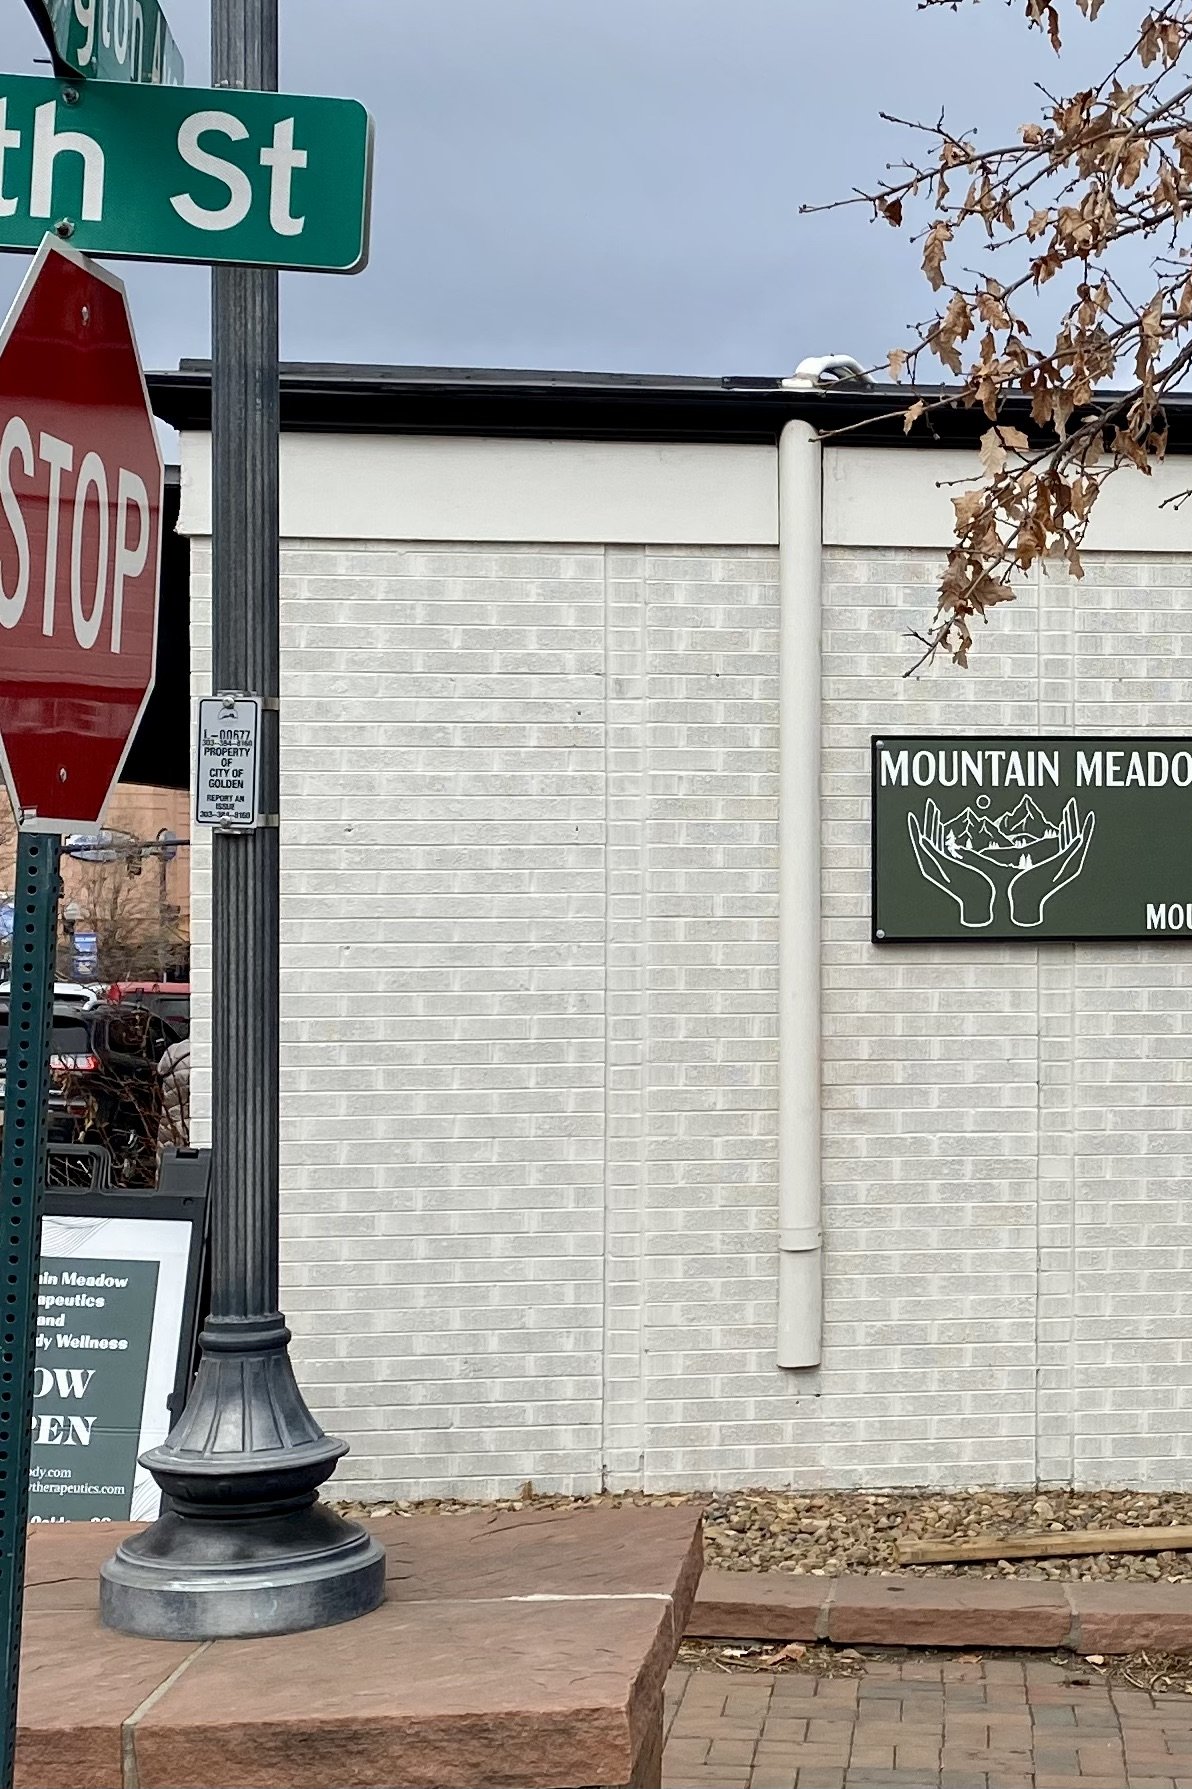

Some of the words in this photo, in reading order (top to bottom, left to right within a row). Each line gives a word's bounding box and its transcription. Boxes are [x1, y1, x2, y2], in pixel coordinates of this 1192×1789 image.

[169, 110, 308, 236] St
[0, 416, 151, 653] STOP
[203, 747, 250, 757] PROPERTY
[221, 758, 233, 767] OF
[880, 750, 1060, 787] MOUNTAIN
[209, 768, 231, 778] CITY
[231, 769, 244, 778] OF
[208, 779, 244, 789] GOLDEN
[61, 1271, 129, 1288] Meadow
[36, 1313, 66, 1327] and
[56, 1333, 128, 1350] Wellness
